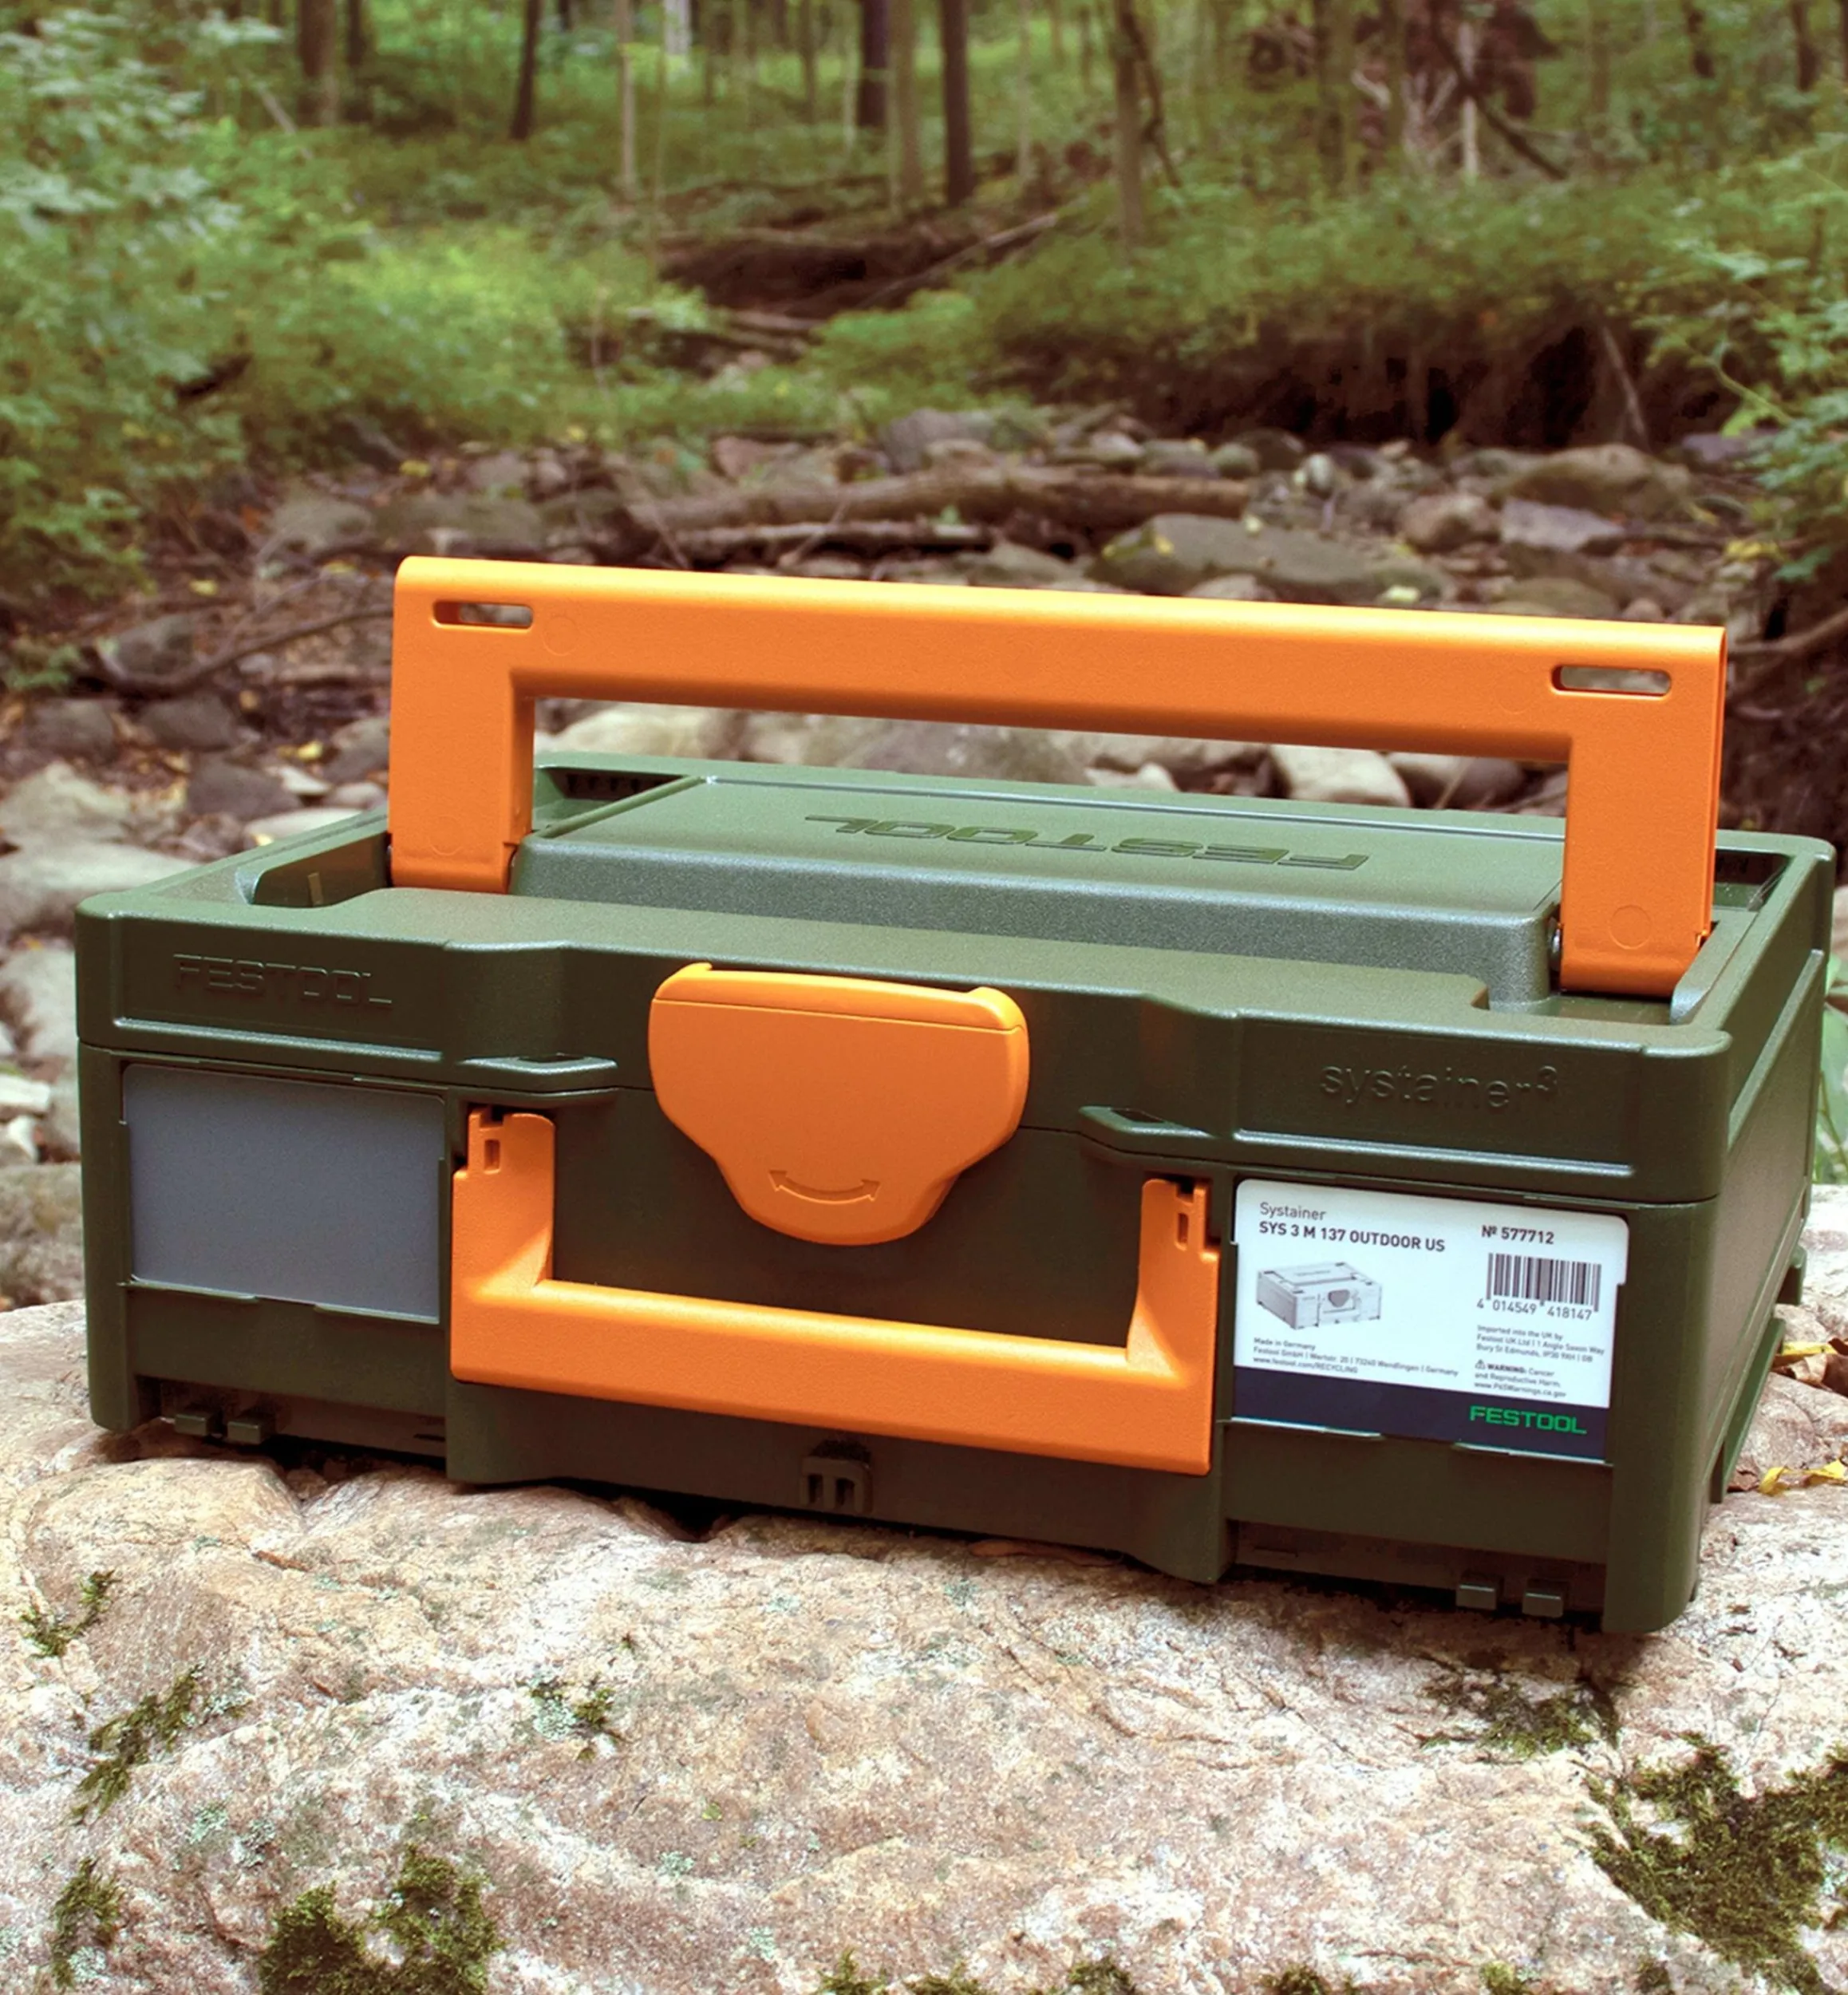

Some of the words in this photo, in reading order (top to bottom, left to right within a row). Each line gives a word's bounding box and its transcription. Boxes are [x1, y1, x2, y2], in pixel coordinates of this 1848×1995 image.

[804, 815, 1370, 871] FESTOOL
[172, 953, 393, 1009] FESTOOL
[1260, 1202, 1326, 1221] Systainer
[1259, 1221, 1286, 1235] SYS
[1291, 1224, 1299, 1237] 3
[1304, 1226, 1315, 1238] M
[1321, 1227, 1345, 1242] 137
[1349, 1230, 1421, 1250] OUTDOOR
[1425, 1238, 1445, 1252] US
[1501, 1227, 1554, 1244] 577712
[1476, 1298, 1484, 1309] 4
[1492, 1299, 1537, 1315] 014549
[1546, 1306, 1592, 1321] 418147
[1477, 1325, 1510, 1335] Imported
[1283, 1341, 1316, 1351] Germany
[1476, 1343, 1494, 1353] Bury
[1477, 1333, 1503, 1343] Festool
[1589, 1346, 1605, 1355] Way
[1253, 1346, 1279, 1355] Festool
[1281, 1349, 1303, 1358] GmbH
[1377, 1359, 1420, 1372] Wendlingen
[1426, 1366, 1459, 1377] Germany
[1253, 1355, 1358, 1373] www.festool.com/RECYCLING
[1487, 1363, 1527, 1374] WARNING:
[1528, 1367, 1555, 1377] Cancer
[1490, 1373, 1537, 1385] Reproductive
[1469, 1405, 1587, 1435] FESTOOL
